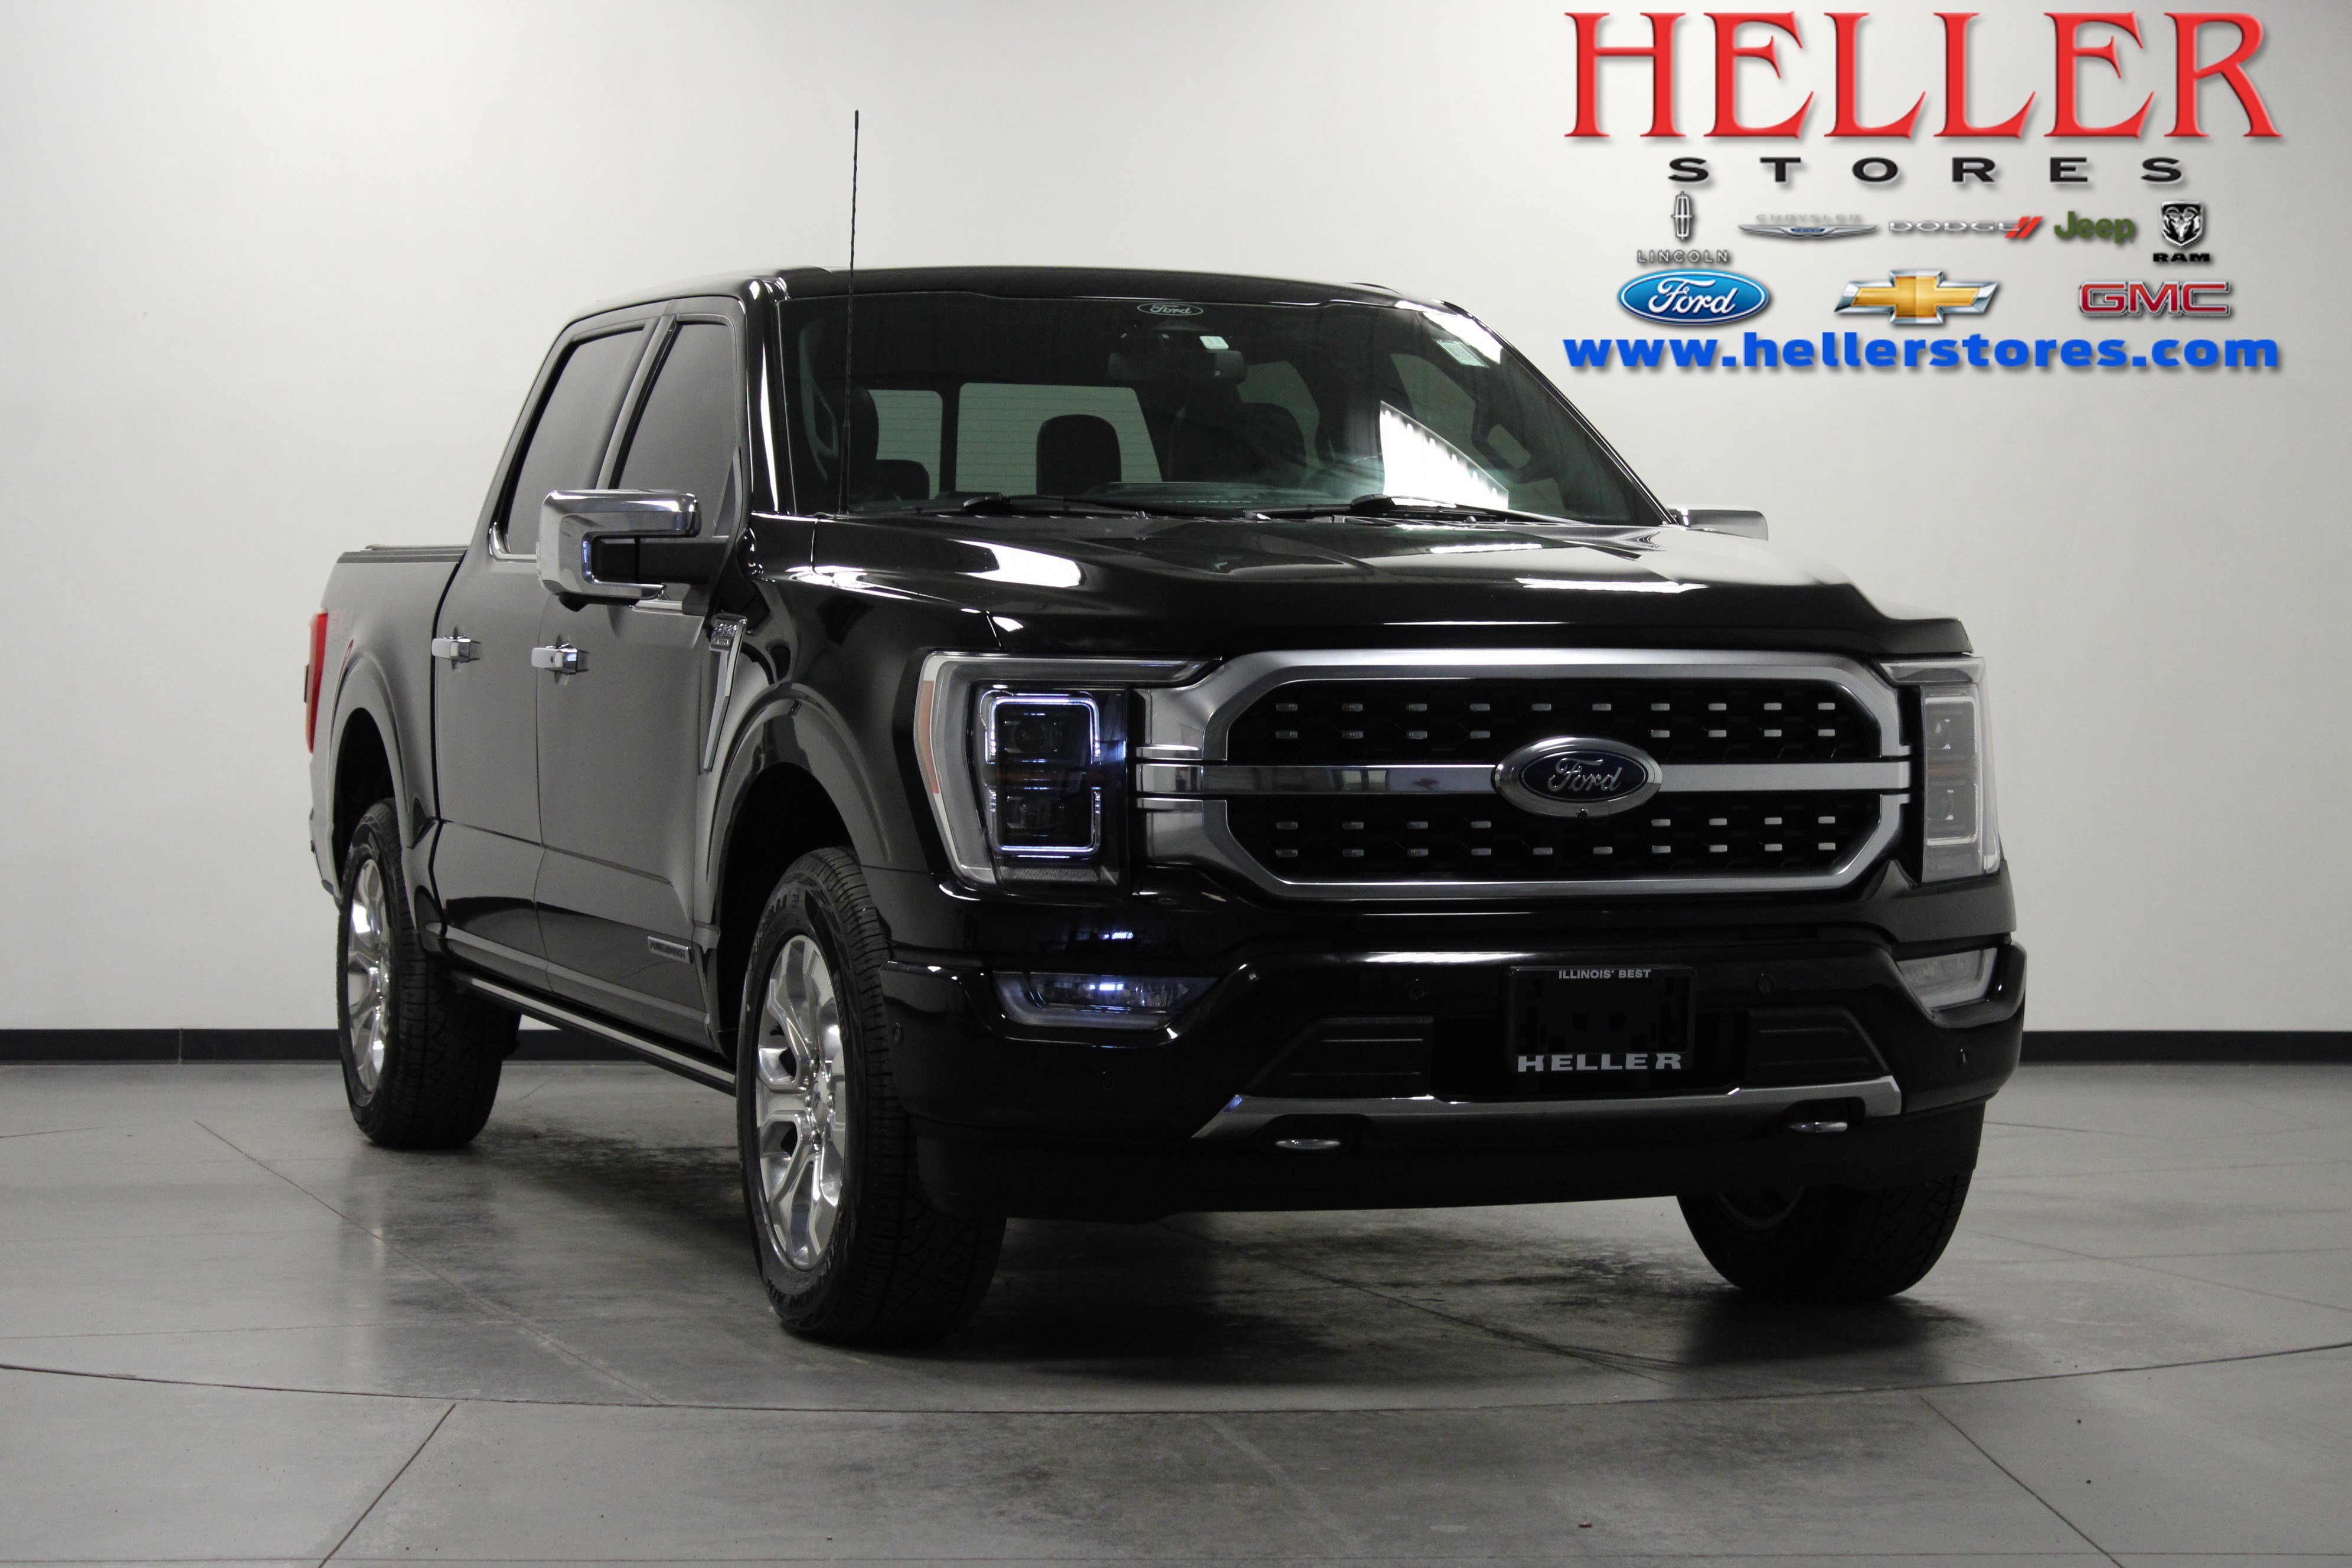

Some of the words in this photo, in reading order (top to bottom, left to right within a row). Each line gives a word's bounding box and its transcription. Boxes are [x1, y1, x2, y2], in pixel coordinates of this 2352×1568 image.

[1149, 304, 1193, 314] Ford
[1547, 757, 1623, 792] Ford
[1618, 969, 1651, 979] BEST
[1518, 1053, 1681, 1072] HELLER
